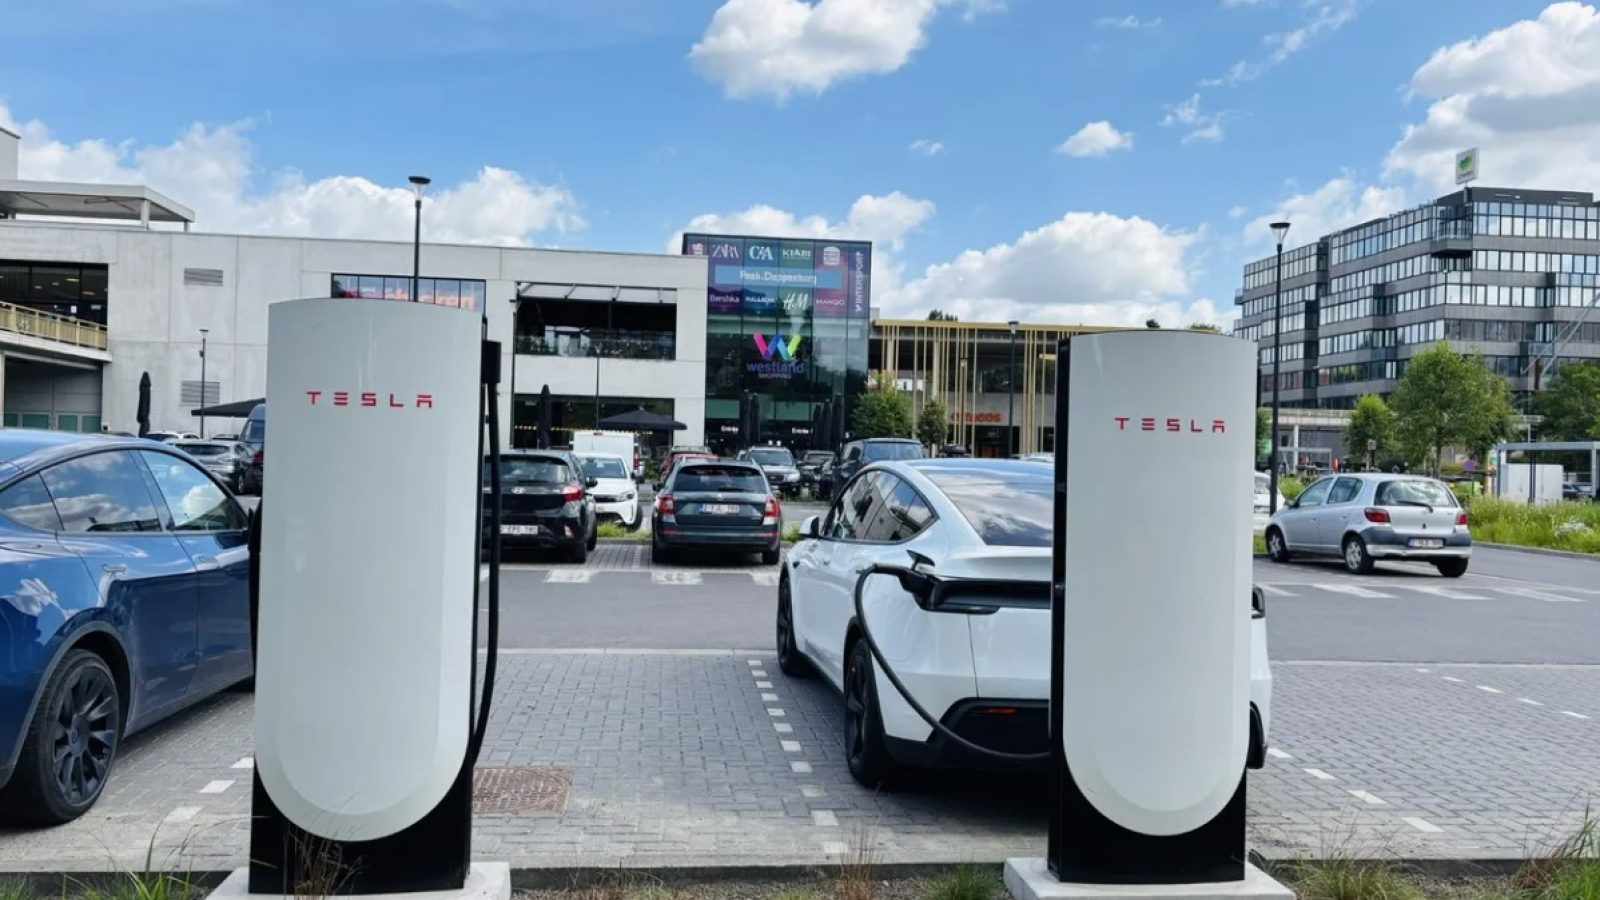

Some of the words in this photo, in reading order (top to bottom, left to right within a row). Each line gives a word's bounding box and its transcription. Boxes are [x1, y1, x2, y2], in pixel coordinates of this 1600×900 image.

[711, 243, 740, 259] ZARA
[710, 294, 740, 304] Bershka
[816, 298, 845, 306] MANGO
[747, 362, 805, 374] westland
[306, 391, 432, 409] TESLA
[1114, 417, 1225, 433] TESLA
